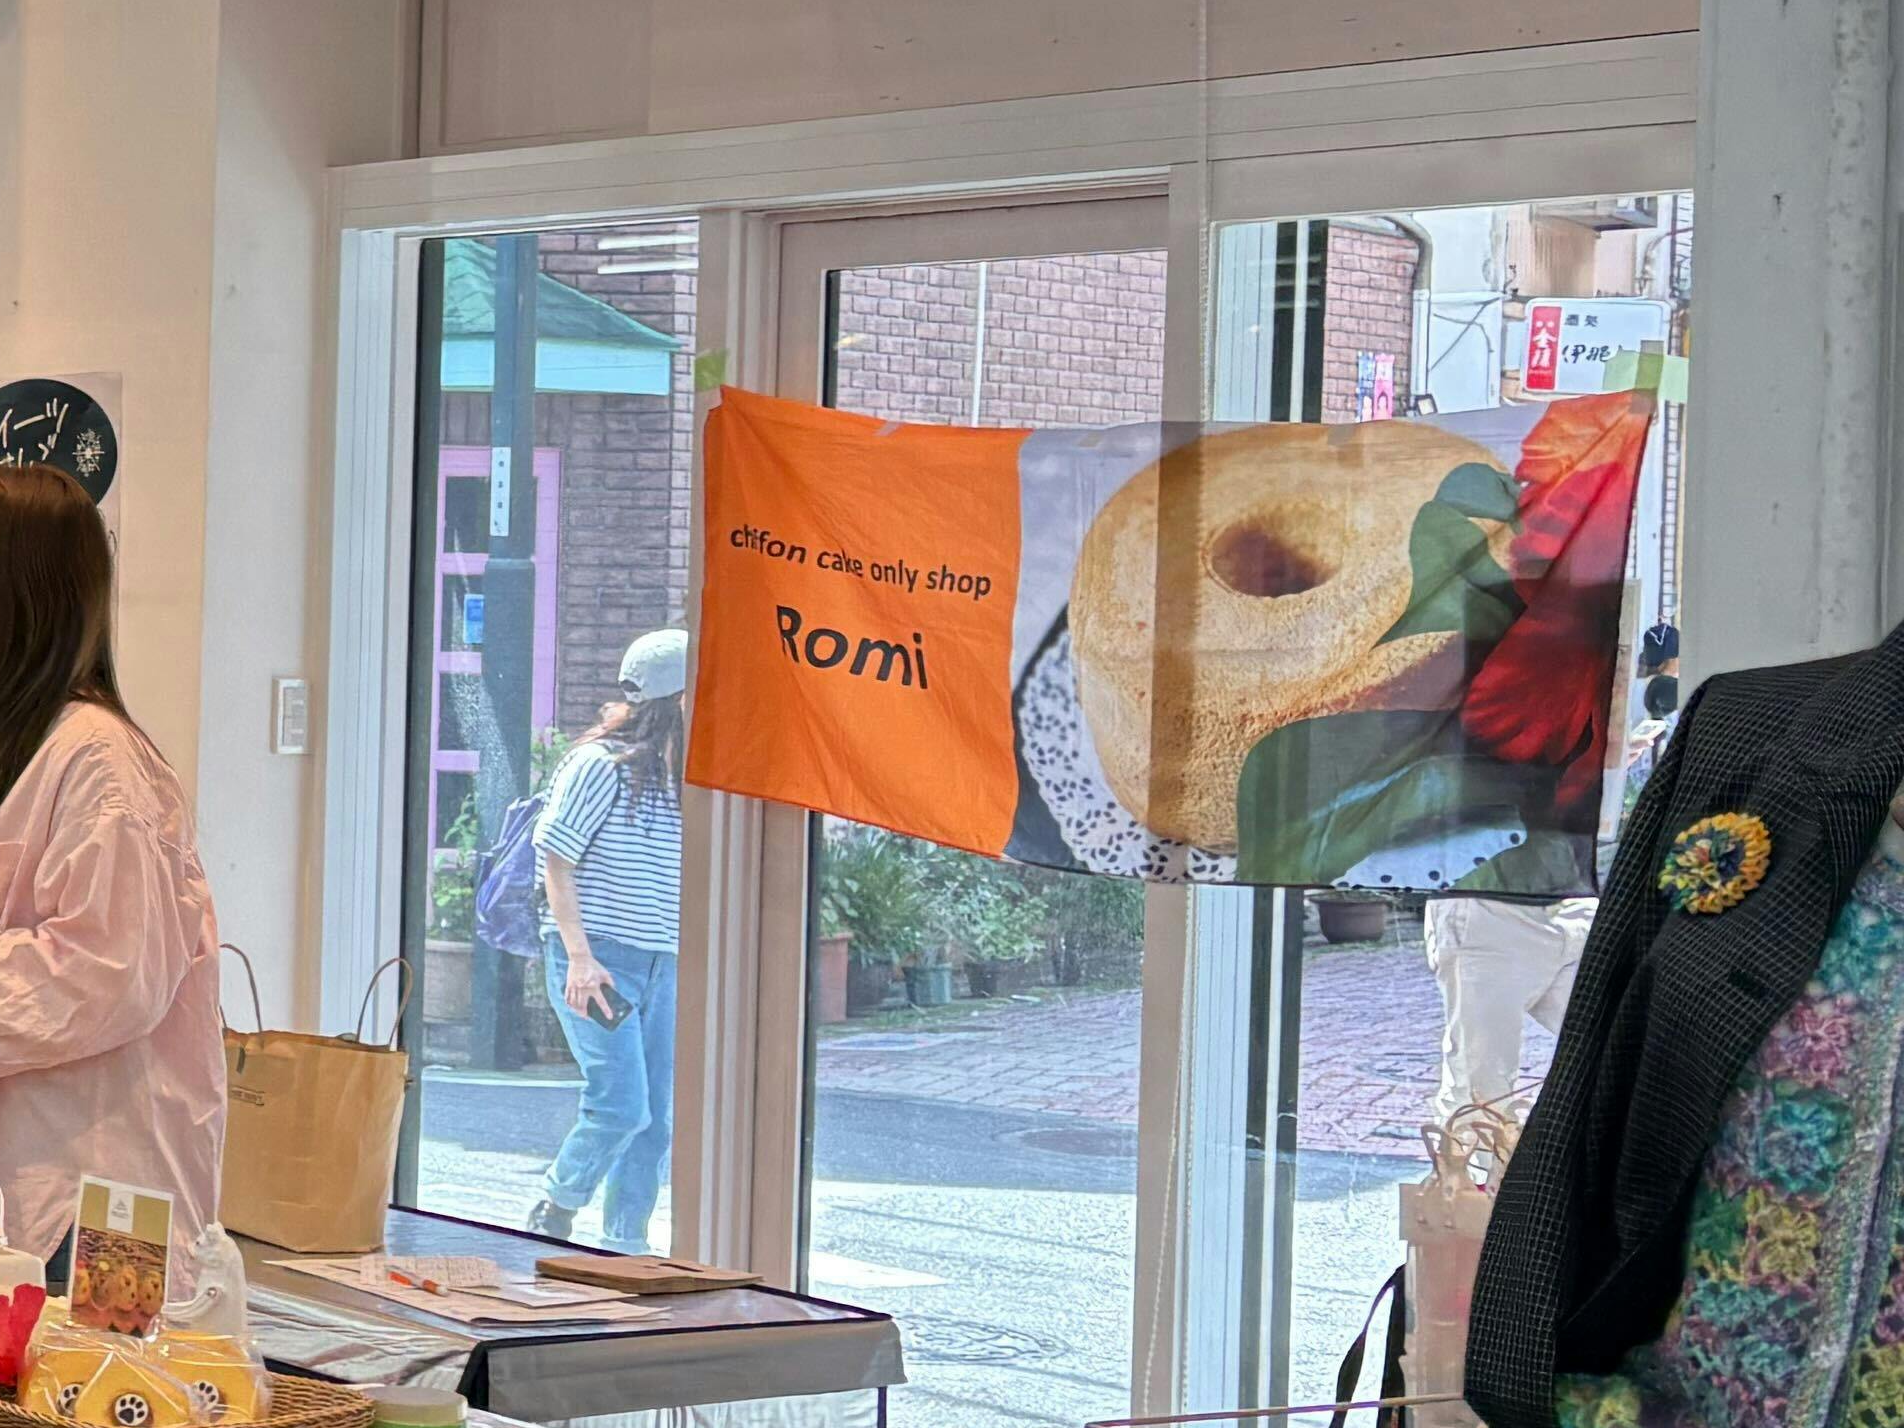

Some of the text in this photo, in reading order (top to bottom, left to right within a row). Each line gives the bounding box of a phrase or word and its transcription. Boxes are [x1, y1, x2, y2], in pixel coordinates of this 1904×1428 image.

[816, 548, 863, 578] cake
[870, 559, 920, 593] only
[925, 563, 992, 601] shop
[775, 604, 929, 690] Romi
